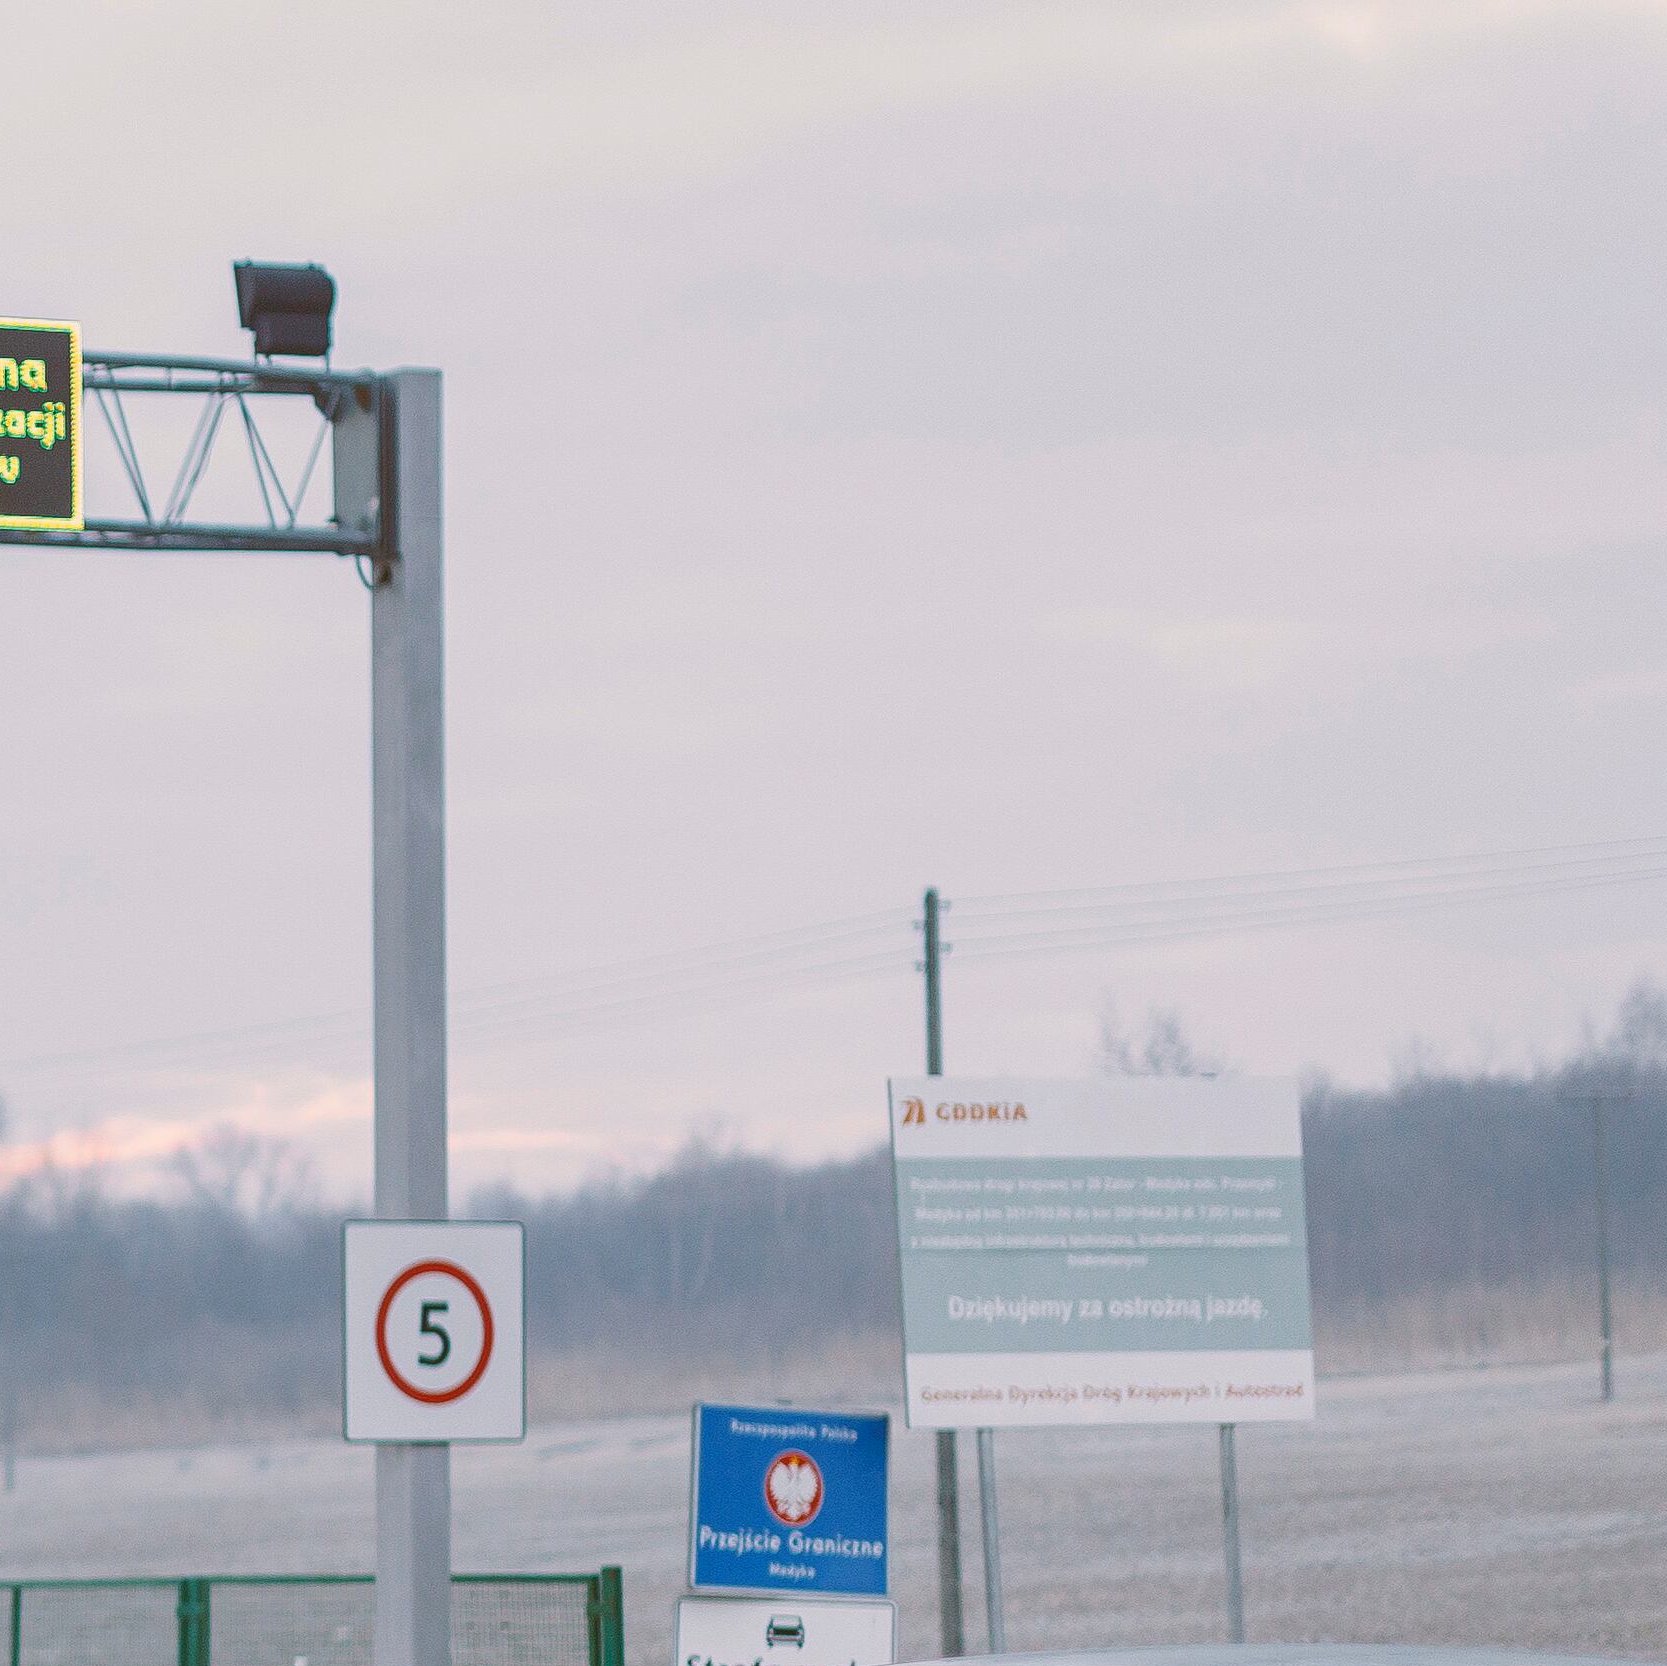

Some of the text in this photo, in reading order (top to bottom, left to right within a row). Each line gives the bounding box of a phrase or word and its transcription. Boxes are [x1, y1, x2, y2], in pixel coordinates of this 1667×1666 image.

[948, 1295, 1072, 1324] Dziękujemy
[1078, 1300, 1104, 1317] za
[417, 1301, 451, 1367] 5
[699, 1525, 884, 1559] Przejście Graniczne
